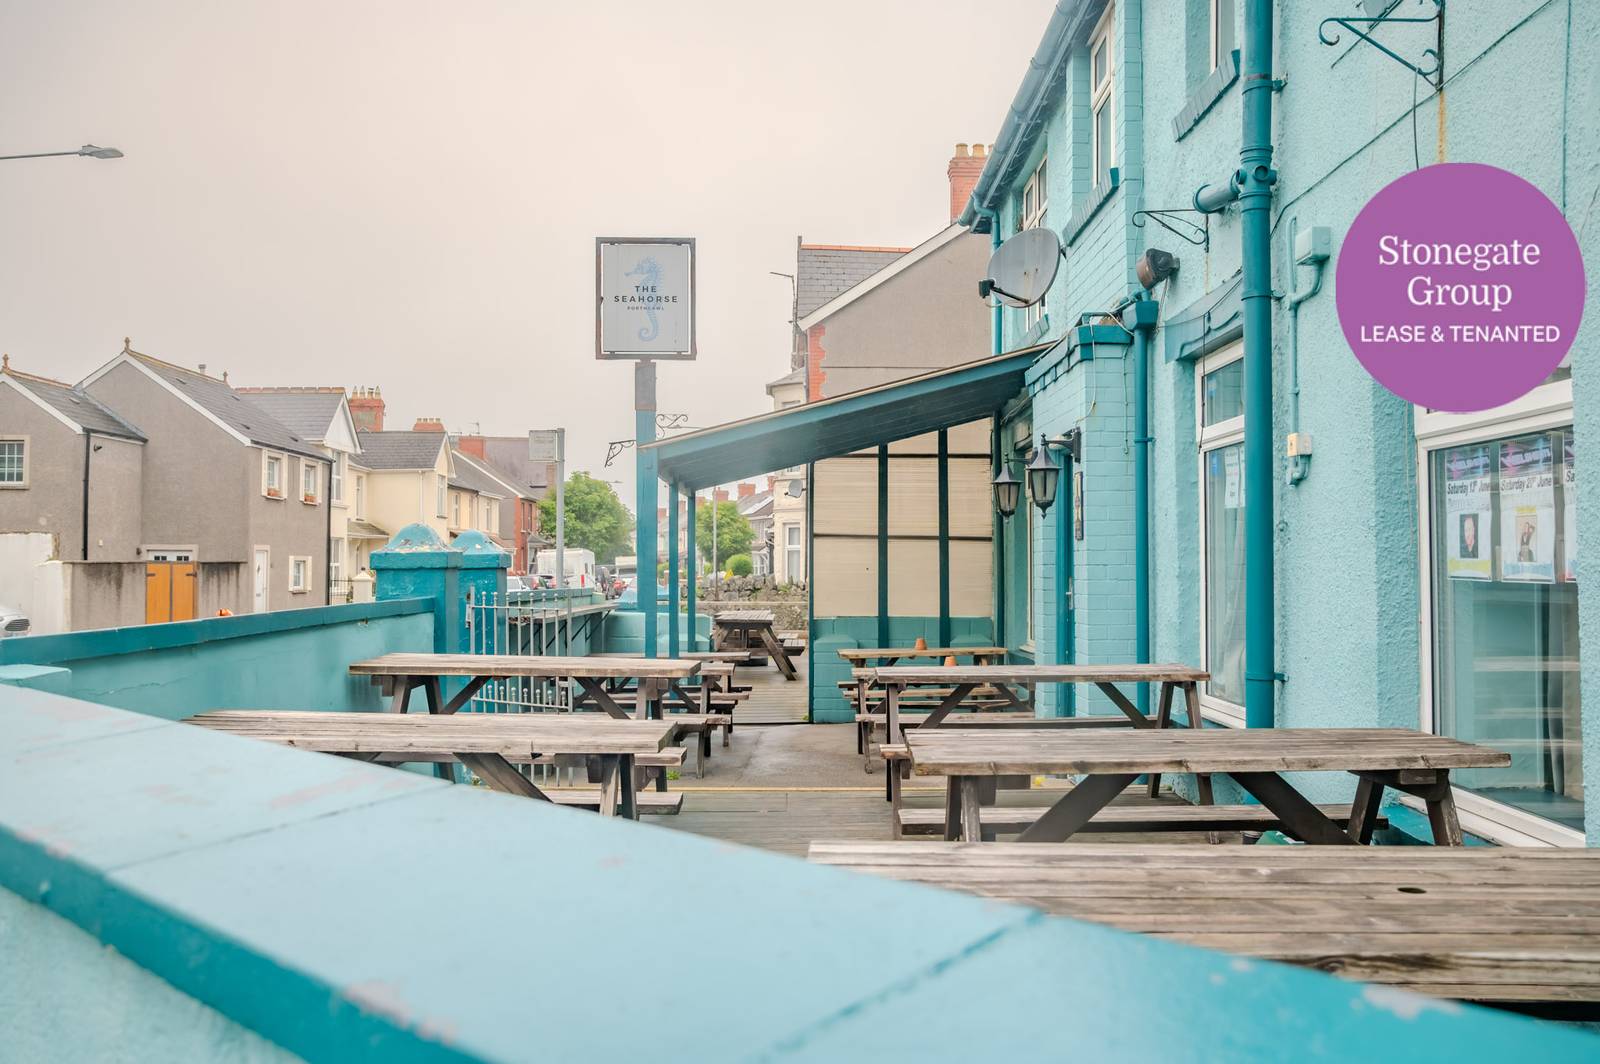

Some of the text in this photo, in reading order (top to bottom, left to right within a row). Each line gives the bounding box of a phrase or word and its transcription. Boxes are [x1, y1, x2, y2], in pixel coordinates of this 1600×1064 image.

[635, 285, 657, 293] THE
[614, 295, 678, 303] SEAHORSE
[1500, 478, 1525, 492] Saturday
